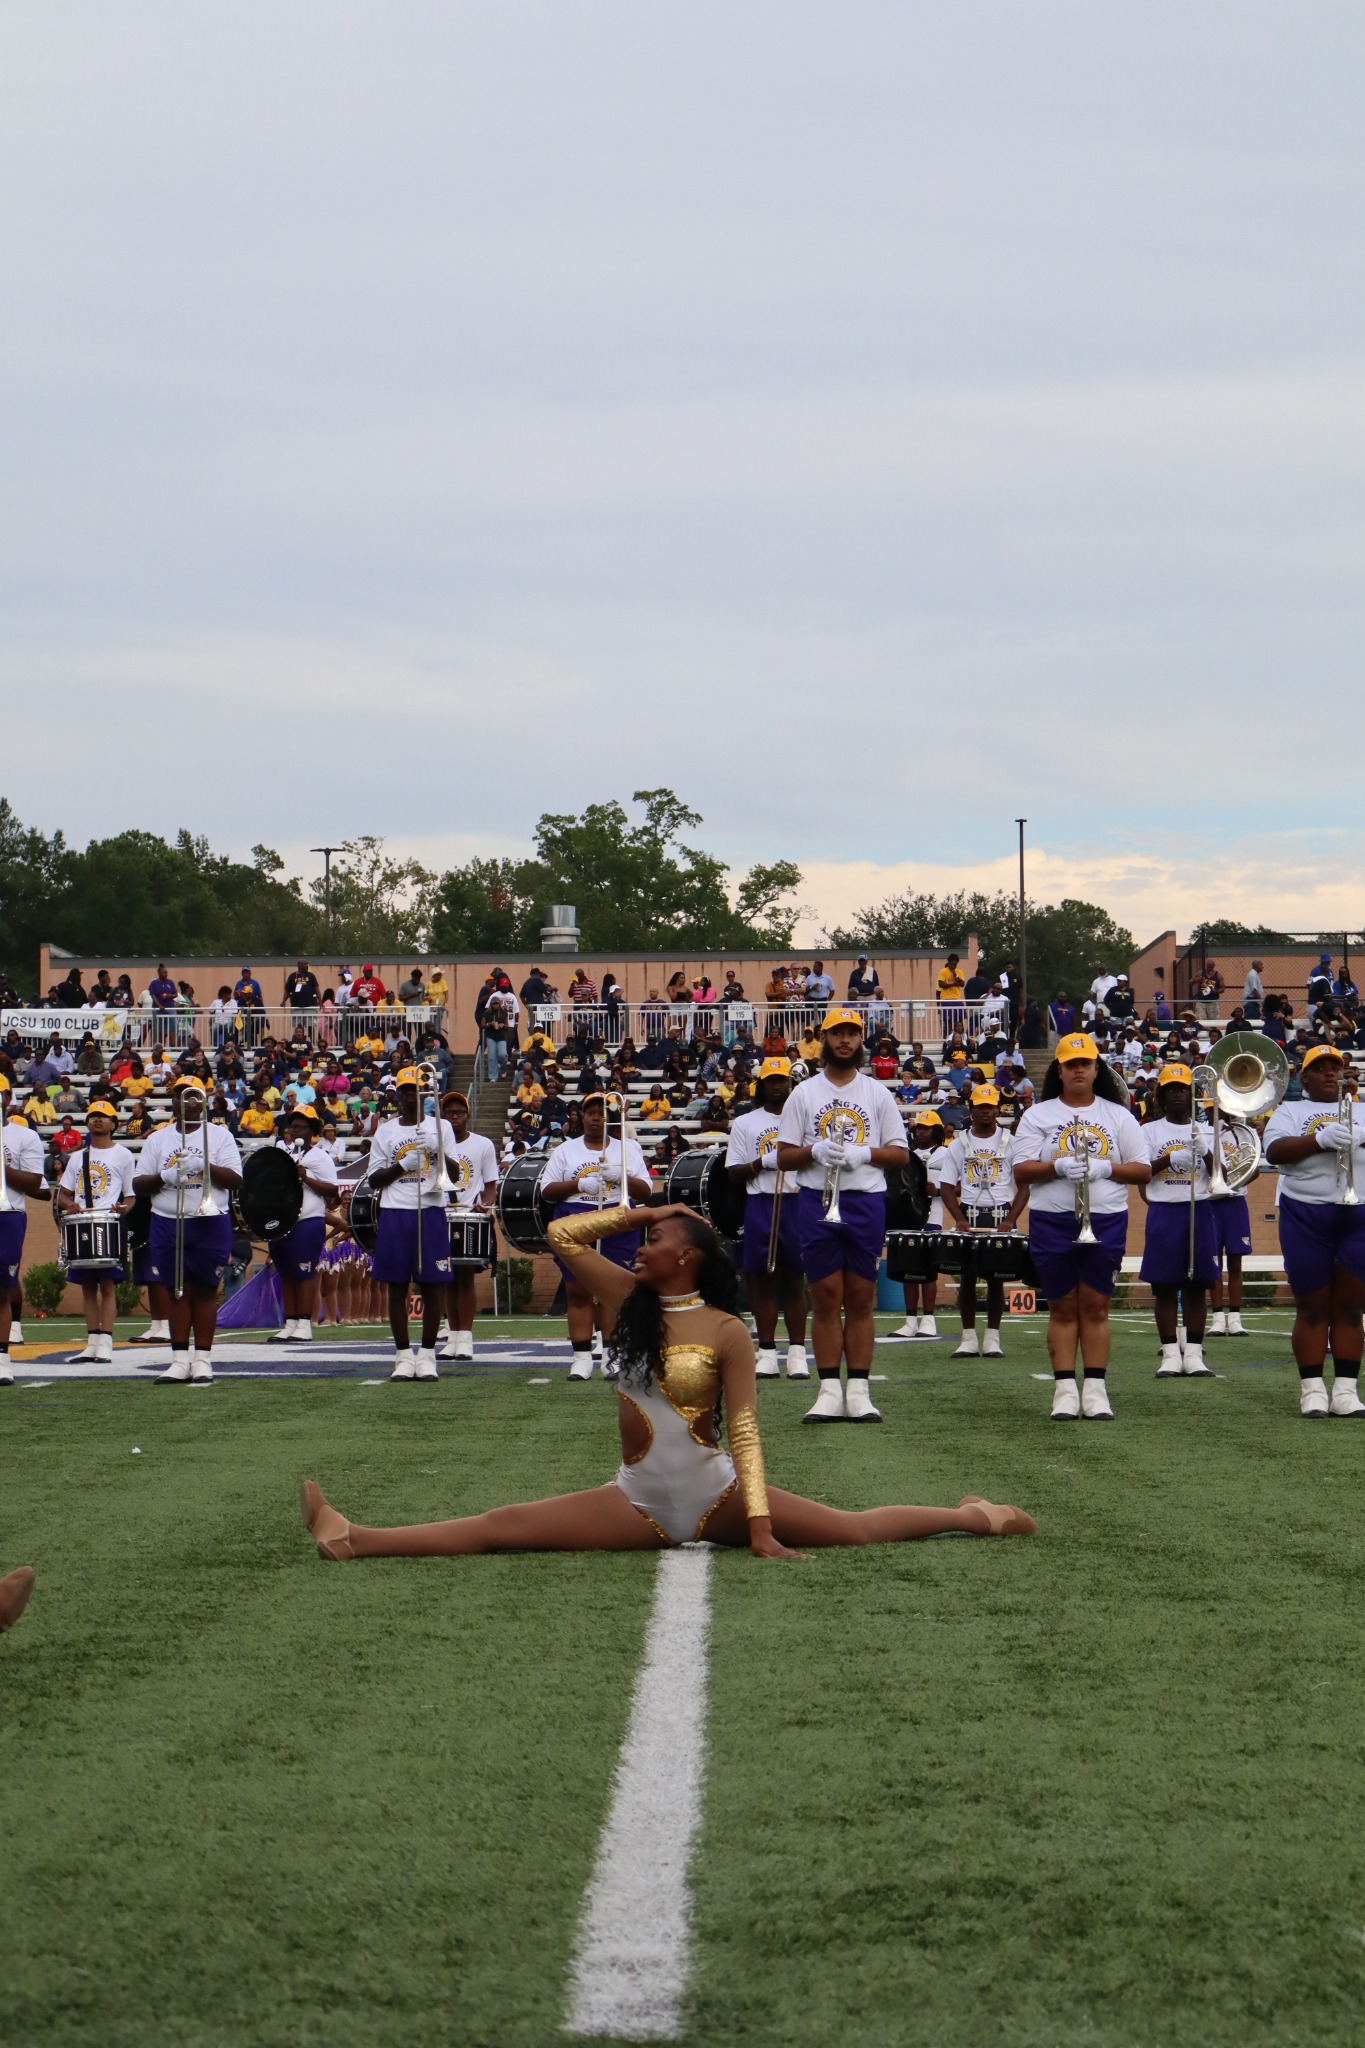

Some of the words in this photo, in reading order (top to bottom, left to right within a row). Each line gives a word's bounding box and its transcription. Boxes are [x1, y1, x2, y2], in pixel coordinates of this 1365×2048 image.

[3, 1016, 36, 1028] JCSU
[41, 1018, 60, 1029] 100
[65, 1019, 99, 1030] CLUB
[852, 1104, 870, 1137] TIGERS
[755, 1126, 779, 1154] MARCHIN
[1094, 1123, 1115, 1151] TIGERS
[101, 1163, 112, 1187] TIGERS
[462, 1155, 475, 1178] TIGERS
[1012, 1293, 1034, 1310] 40
